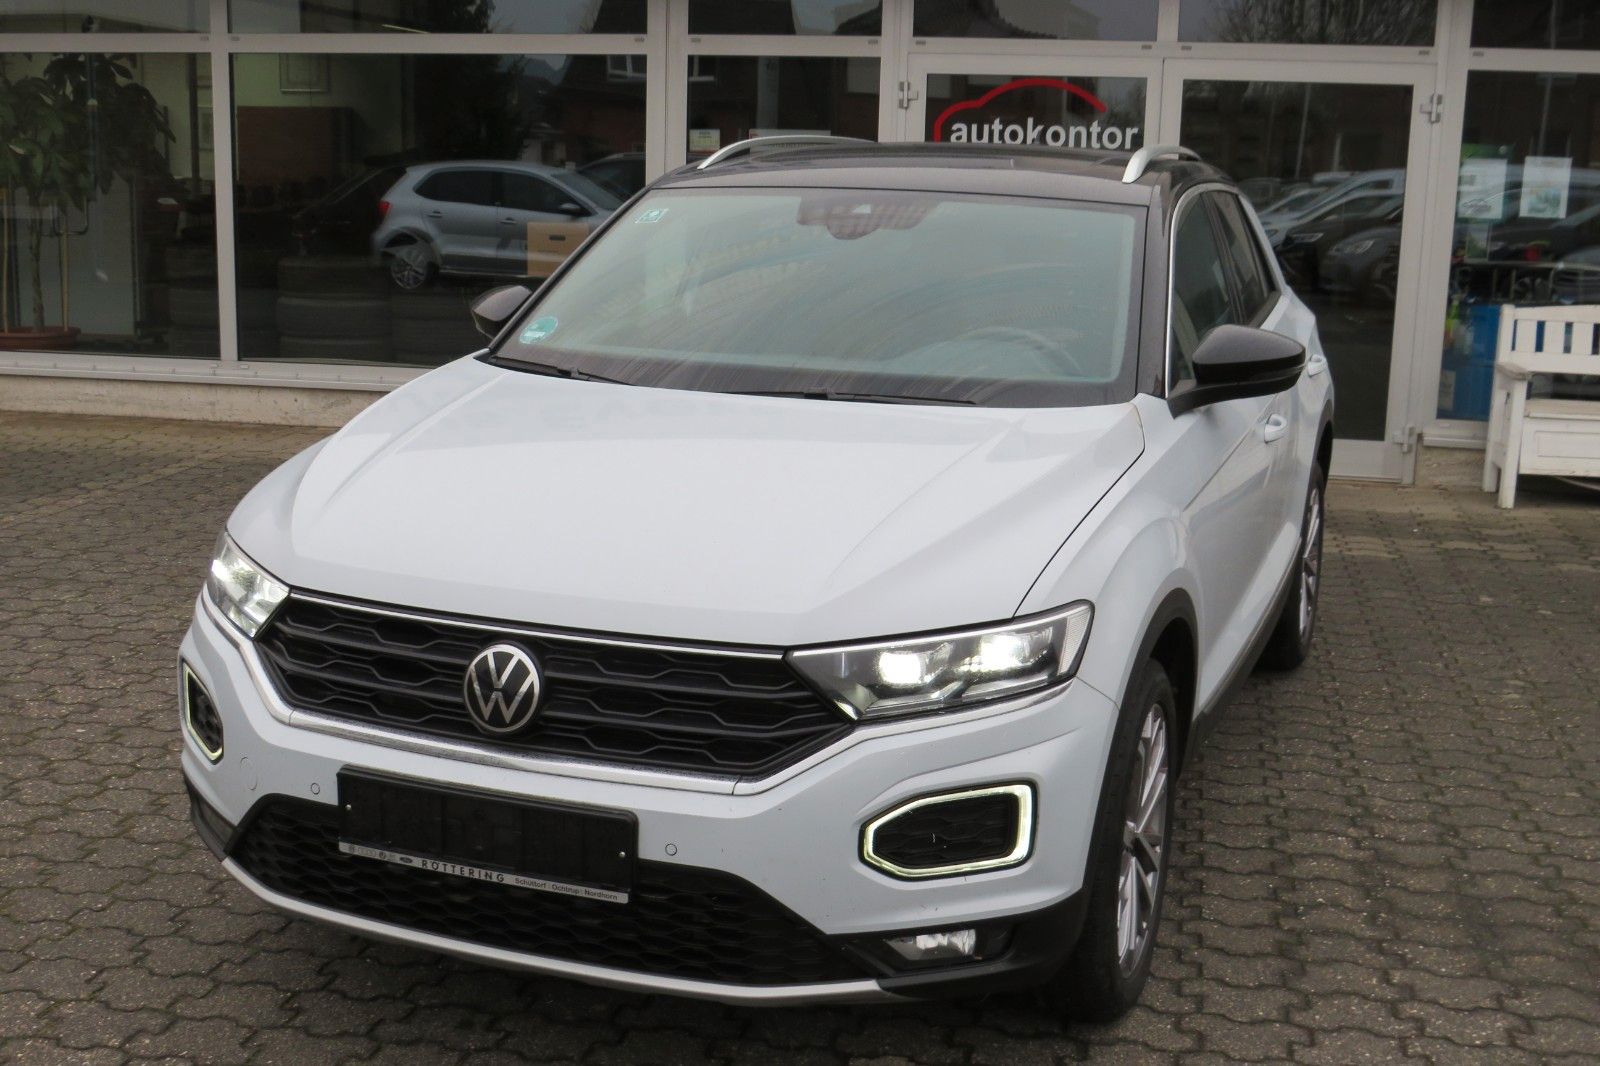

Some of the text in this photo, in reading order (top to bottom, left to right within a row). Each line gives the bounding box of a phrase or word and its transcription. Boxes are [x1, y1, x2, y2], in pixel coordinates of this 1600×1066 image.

[950, 117, 1139, 149] autokontor
[468, 648, 537, 726] VW
[421, 859, 504, 882] RÖTTERING
[584, 888, 618, 901] Nordhorn
